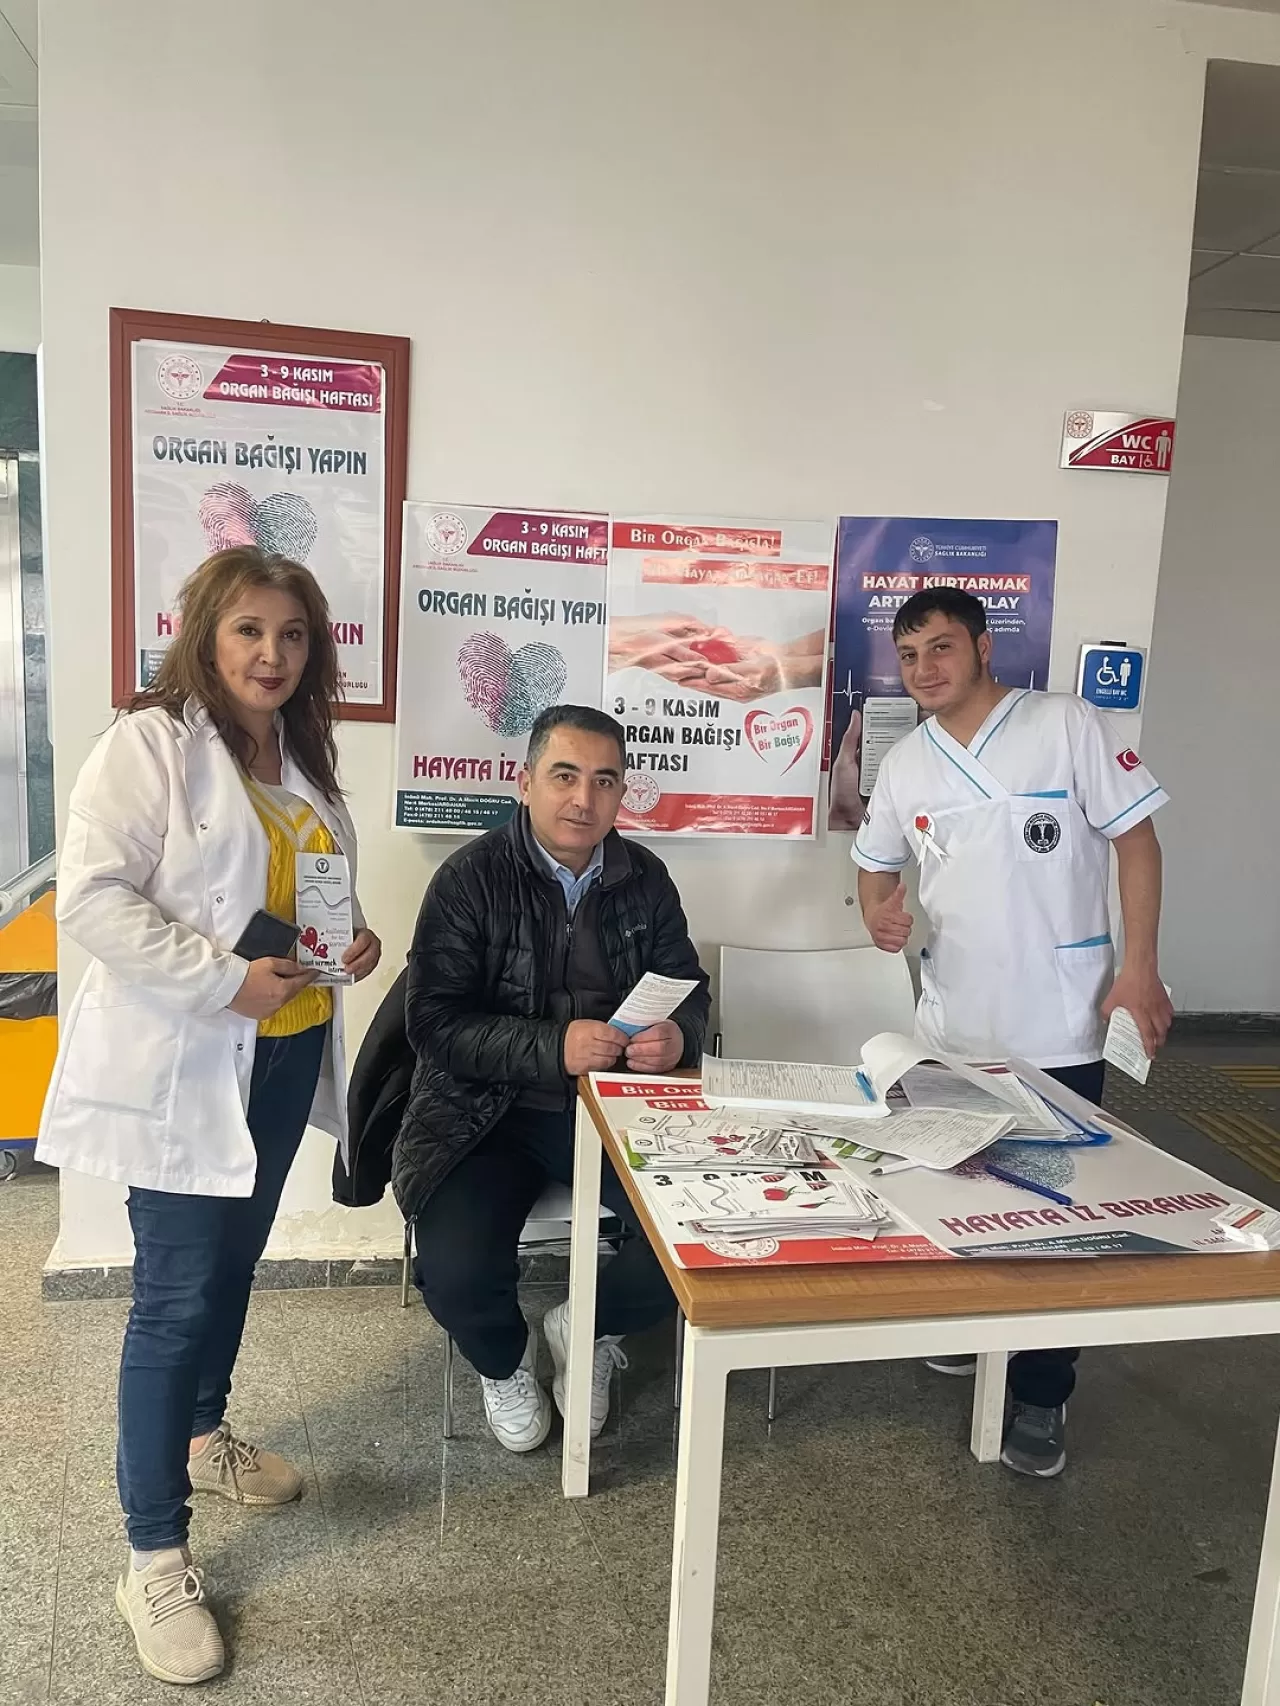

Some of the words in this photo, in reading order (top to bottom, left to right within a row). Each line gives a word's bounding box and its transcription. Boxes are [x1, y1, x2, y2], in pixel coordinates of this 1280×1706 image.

[260, 364, 268, 377] 3
[280, 366, 289, 378] 9
[293, 367, 333, 382] KASIM
[220, 382, 268, 398] ORGAN
[272, 383, 315, 404] BAĞIŞI
[320, 391, 372, 406] HAFTASI
[1122, 435, 1152, 450] WC
[152, 435, 227, 464] ORGAN
[235, 435, 301, 475] BAĞIŞI
[308, 448, 367, 475] YAPIN
[1111, 455, 1136, 465] BAY
[521, 521, 528, 534] 3
[540, 523, 548, 535] 9
[552, 524, 589, 539] KASIM
[483, 538, 527, 553] ORGAN
[531, 539, 571, 559] BAĞIŞI
[576, 546, 608, 559] HAFT
[863, 576, 918, 589] HAYAT
[923, 577, 1029, 591] KURTARMAK
[418, 589, 487, 616] ORGAN
[493, 588, 556, 625] BAĞIŞI
[977, 596, 1020, 609] OLAY
[614, 697, 625, 715] 3
[645, 698, 655, 716] 9
[663, 699, 720, 718] KASIM
[754, 722, 767, 734] Bir
[770, 719, 798, 731] Organ
[626, 725, 674, 744] RGAN
[682, 723, 741, 751] BAĞIŞI
[758, 739, 771, 750] Bir
[774, 734, 800, 747] Bağış
[413, 755, 492, 782] HAYATA
[500, 752, 516, 782] İZ
[626, 753, 688, 771] AFTASI
[653, 1174, 673, 1186] 3
[938, 1208, 1070, 1236] HAYATA
[1098, 1192, 1231, 1218] BIRAKIN
